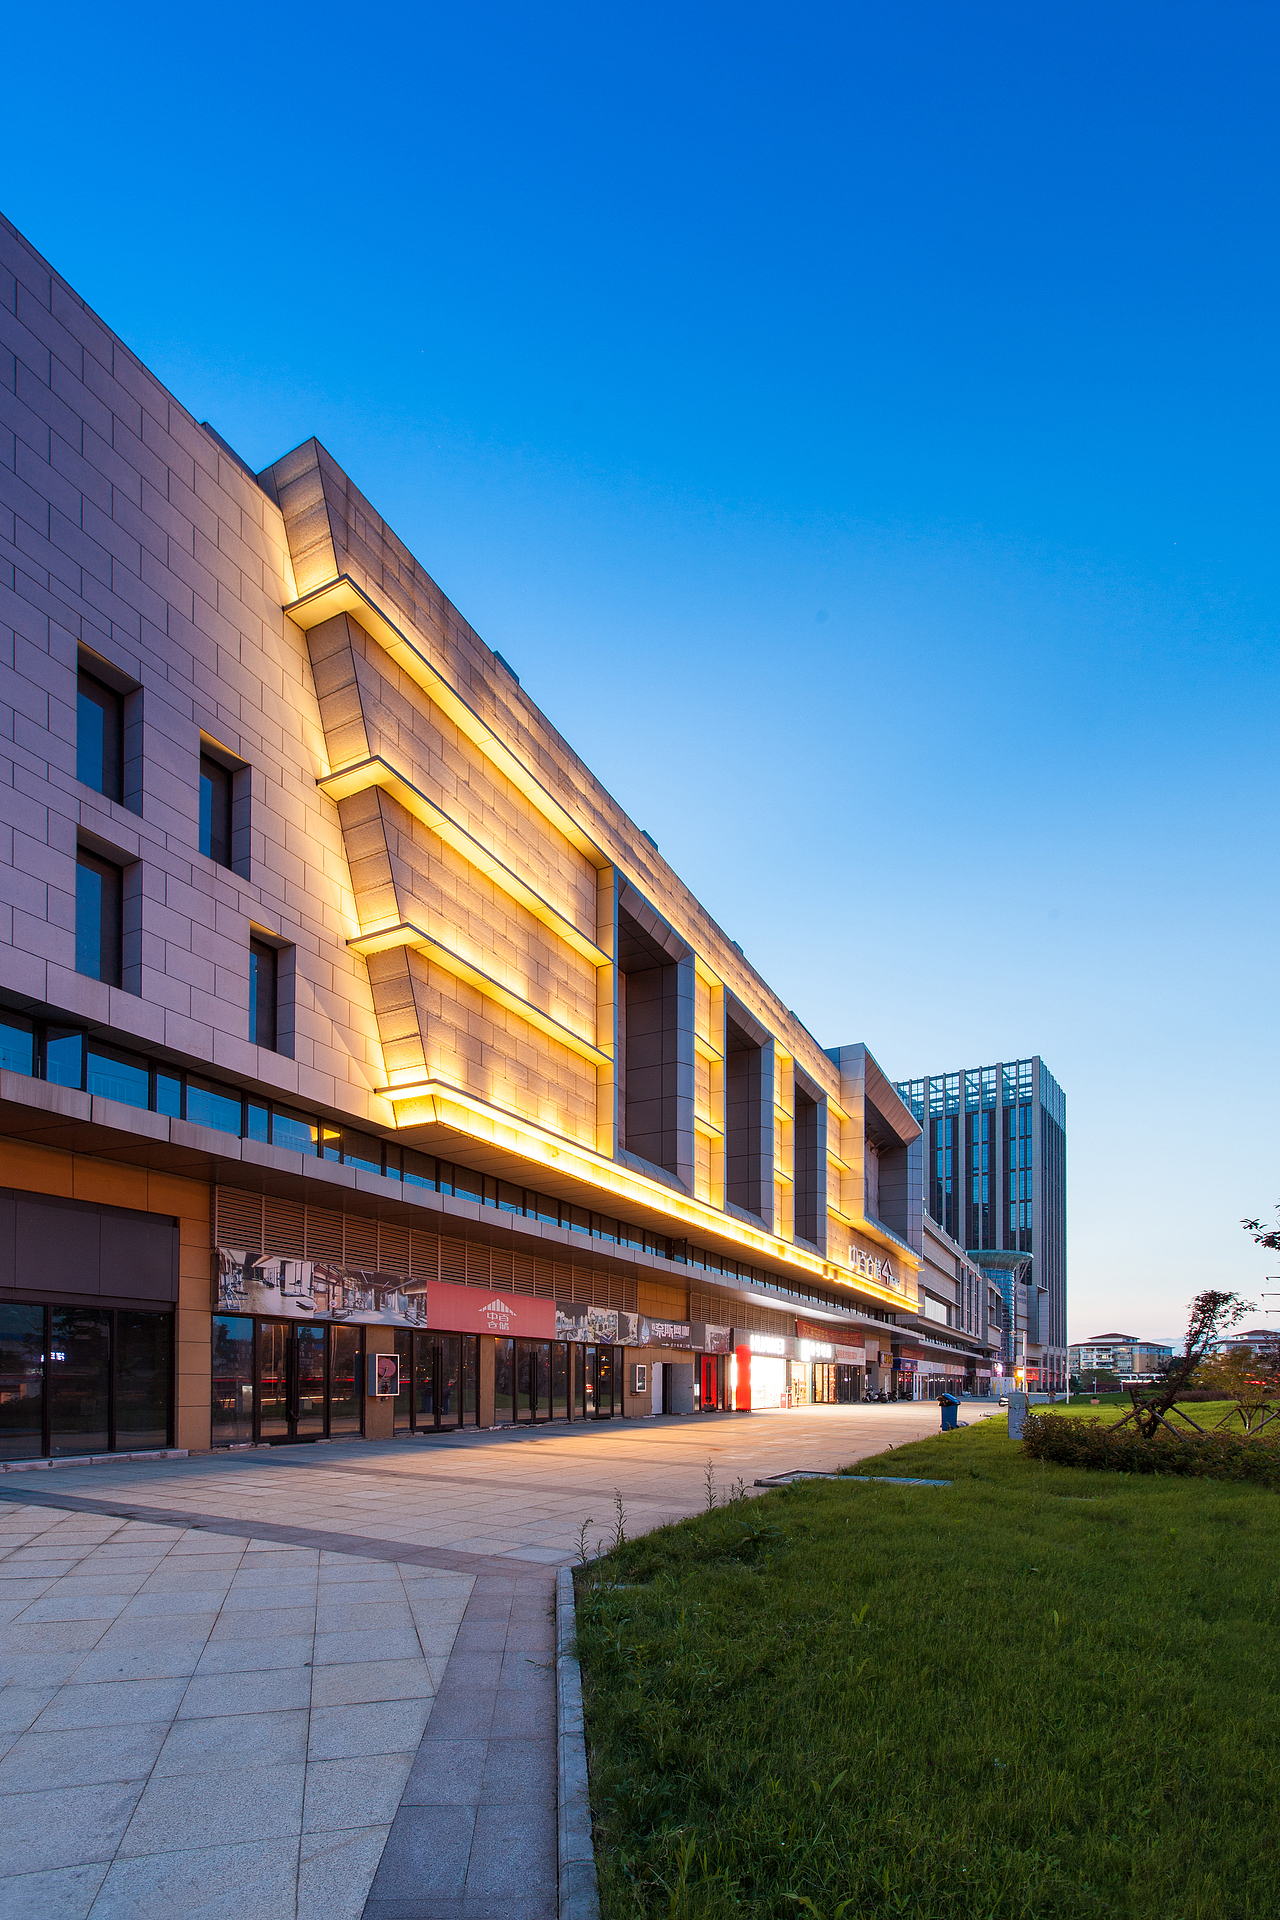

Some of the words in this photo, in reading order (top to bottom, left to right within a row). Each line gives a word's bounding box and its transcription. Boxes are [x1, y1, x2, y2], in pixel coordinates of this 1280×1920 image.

[848, 1244, 881, 1281] 中百仓储
[486, 1312, 509, 1322] 中百
[487, 1321, 510, 1331] 仓储
